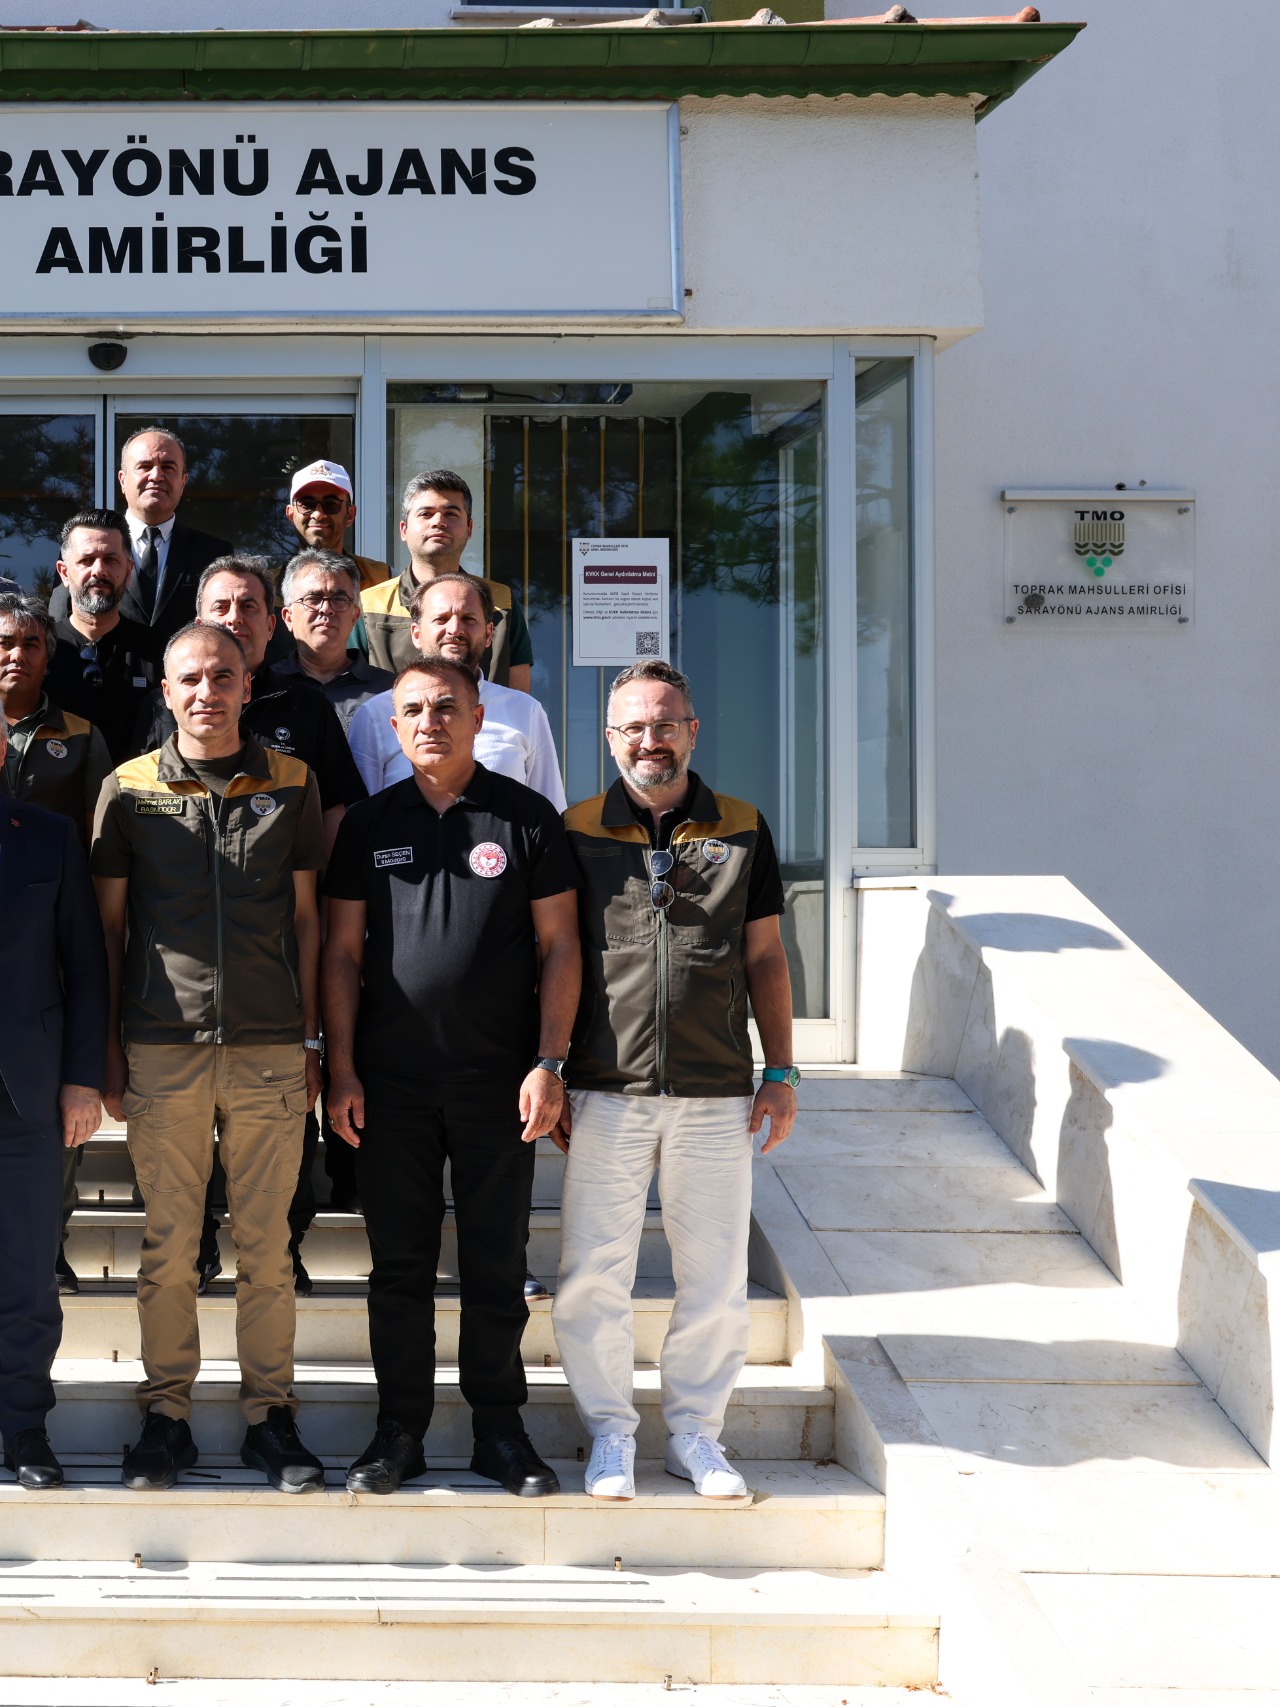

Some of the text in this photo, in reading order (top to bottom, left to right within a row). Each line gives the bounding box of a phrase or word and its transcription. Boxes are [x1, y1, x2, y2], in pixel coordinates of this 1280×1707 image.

[295, 146, 538, 198] AJANS
[35, 210, 369, 275] AMİRLİĞİ
[1074, 510, 1125, 521] TMO
[1013, 583, 1186, 595] TOPRAK MAHSULLERİ OFİSİ
[1017, 603, 1182, 615] SARAYÖNÜ AJANS AMİRLİĞİ
